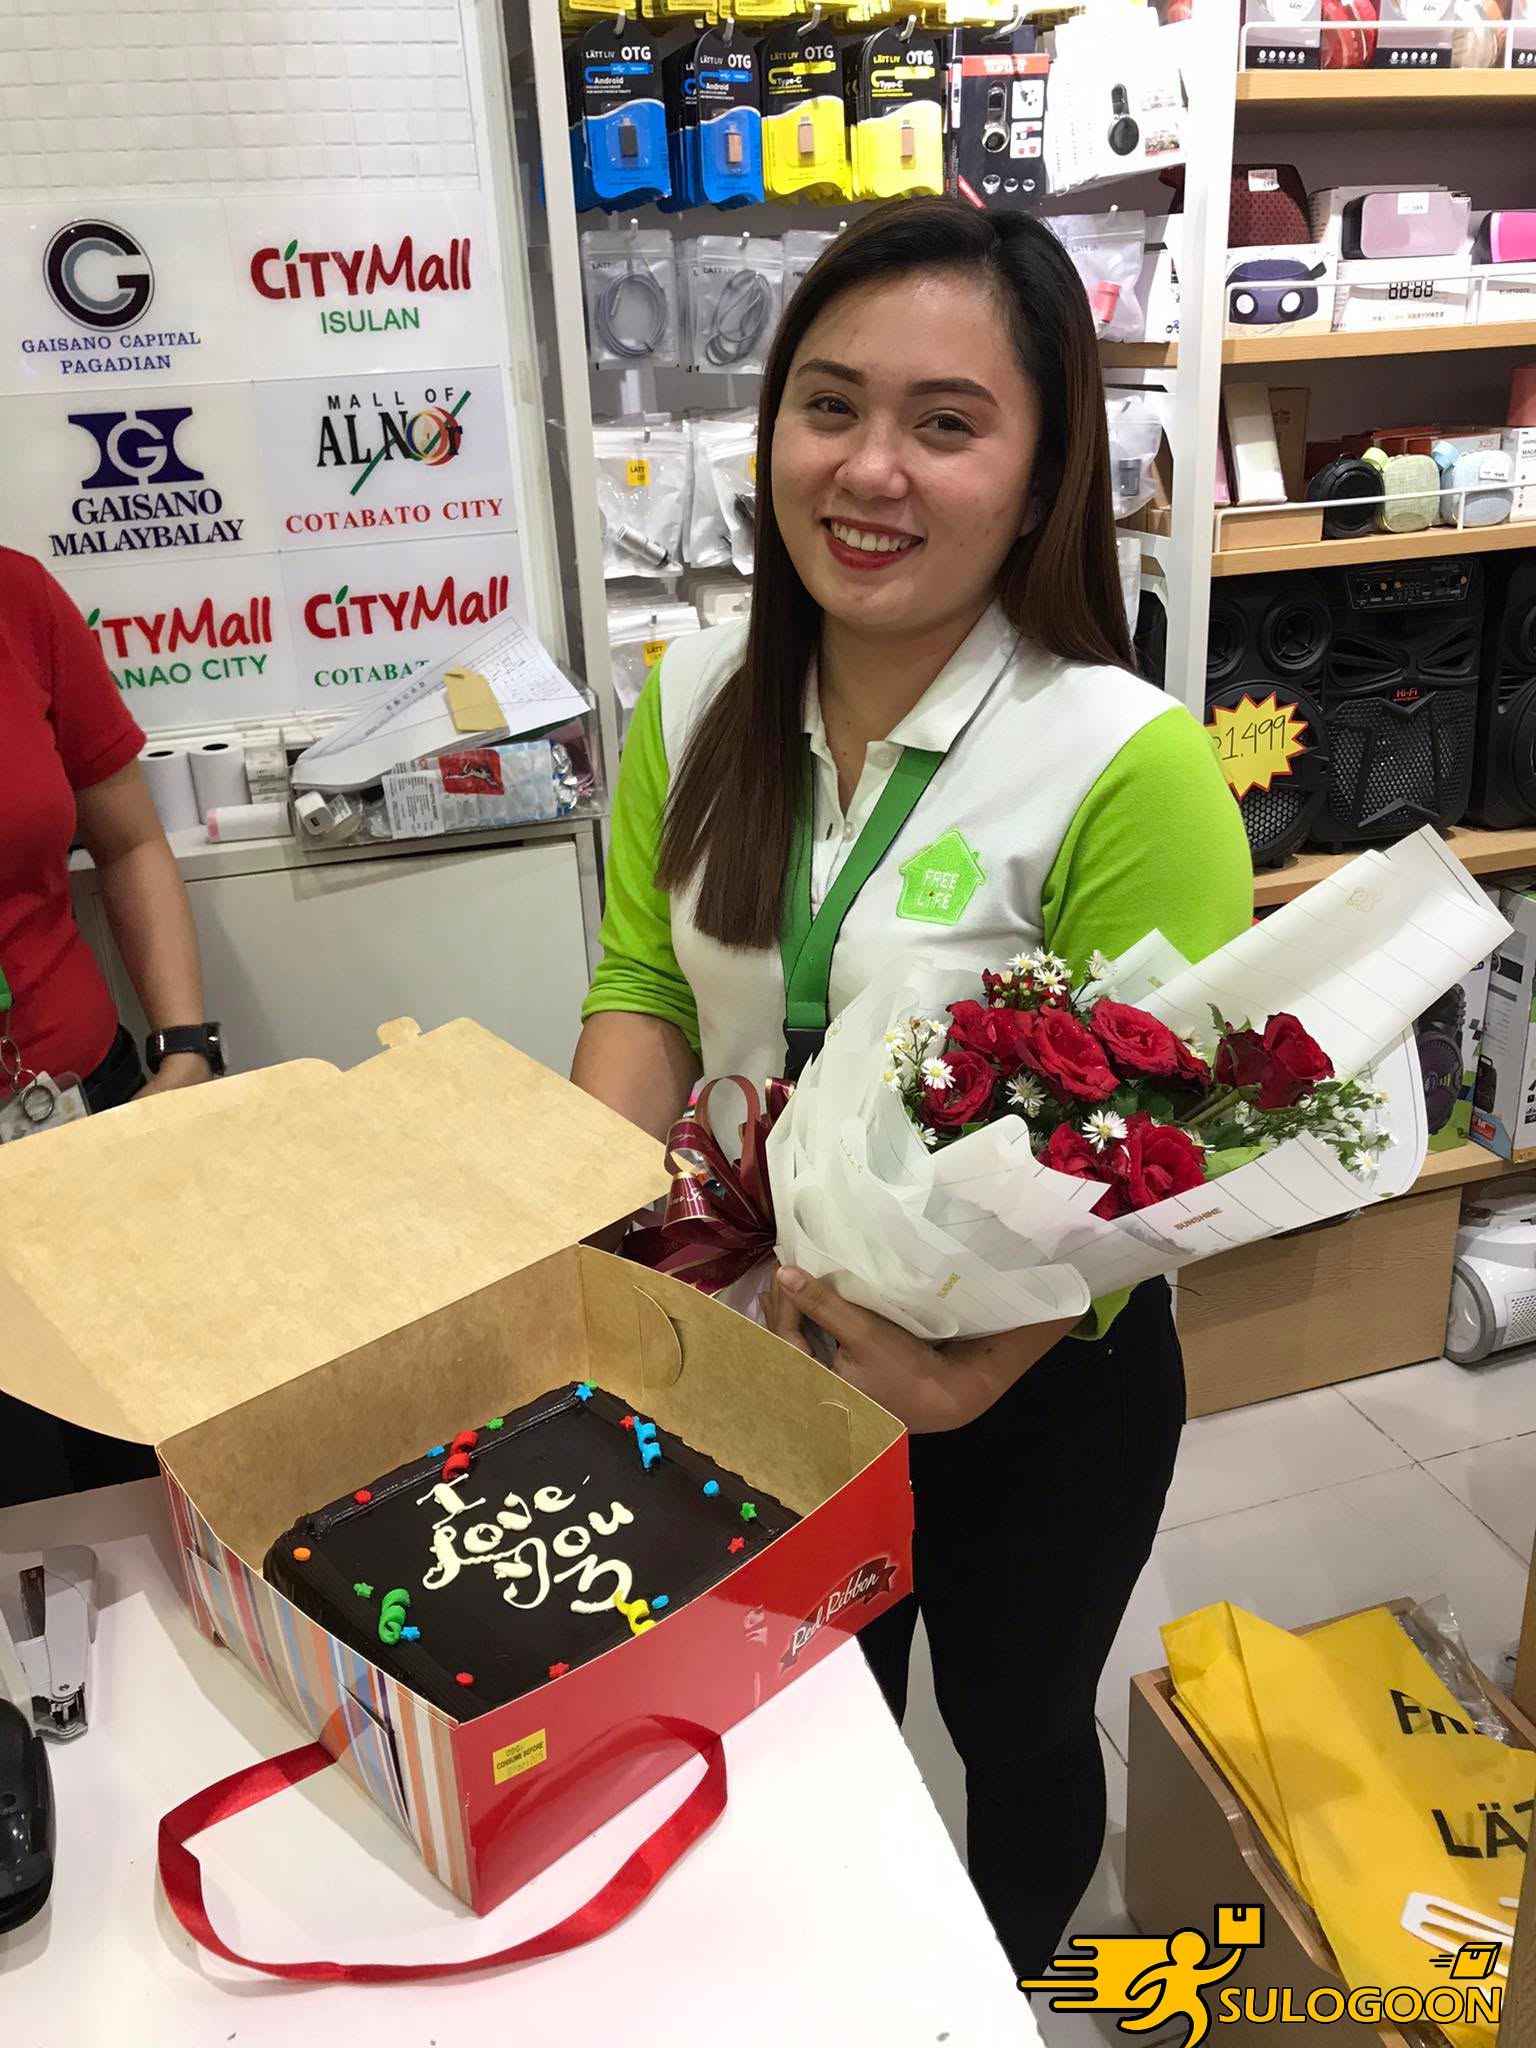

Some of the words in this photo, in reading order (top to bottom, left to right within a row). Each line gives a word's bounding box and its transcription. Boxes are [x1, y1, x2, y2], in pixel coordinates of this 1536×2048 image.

[621, 46, 651, 61] OTG
[728, 53, 751, 69] OTG
[805, 45, 834, 60] OTG
[906, 50, 934, 65] OTG
[594, 76, 624, 86] Android
[706, 82, 730, 92] Android
[321, 308, 420, 334] ISULAN
[21, 336, 112, 354] GAISANO
[120, 332, 201, 349] CAPITAL
[60, 355, 171, 374] PAGADIAN
[328, 391, 404, 410] MALL
[425, 388, 454, 403] OF
[71, 488, 223, 526] GAISANO
[286, 504, 431, 534] COTABATO
[442, 498, 503, 521] CITY
[49, 519, 244, 558] MALAYBALAY
[202, 653, 267, 680] CITY
[314, 660, 430, 688] COTABA
[416, 1473, 486, 1530] I
[792, 1606, 825, 1656] Red
[826, 1569, 880, 1622] Ribbon
